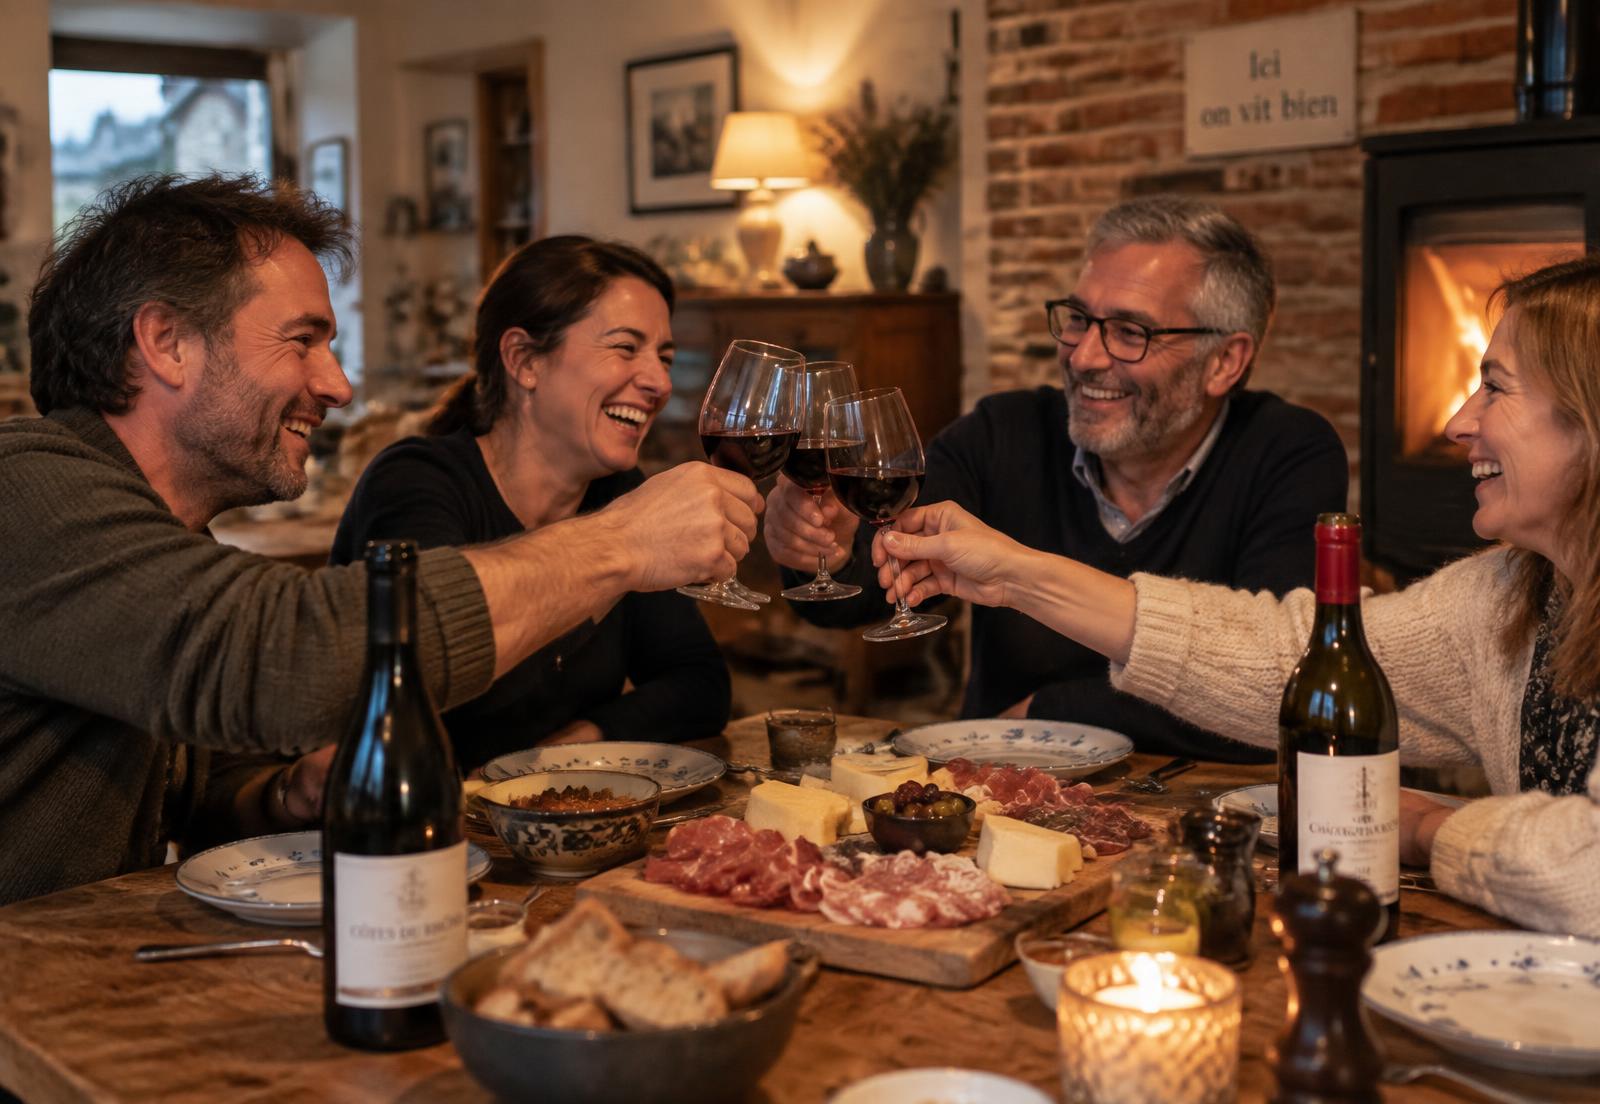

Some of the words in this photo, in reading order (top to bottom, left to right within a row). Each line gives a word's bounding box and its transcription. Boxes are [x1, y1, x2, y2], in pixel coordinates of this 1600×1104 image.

[1249, 49, 1281, 80] Ici
[1201, 105, 1231, 128] on
[1239, 94, 1271, 123] vit
[1281, 89, 1338, 120] bien
